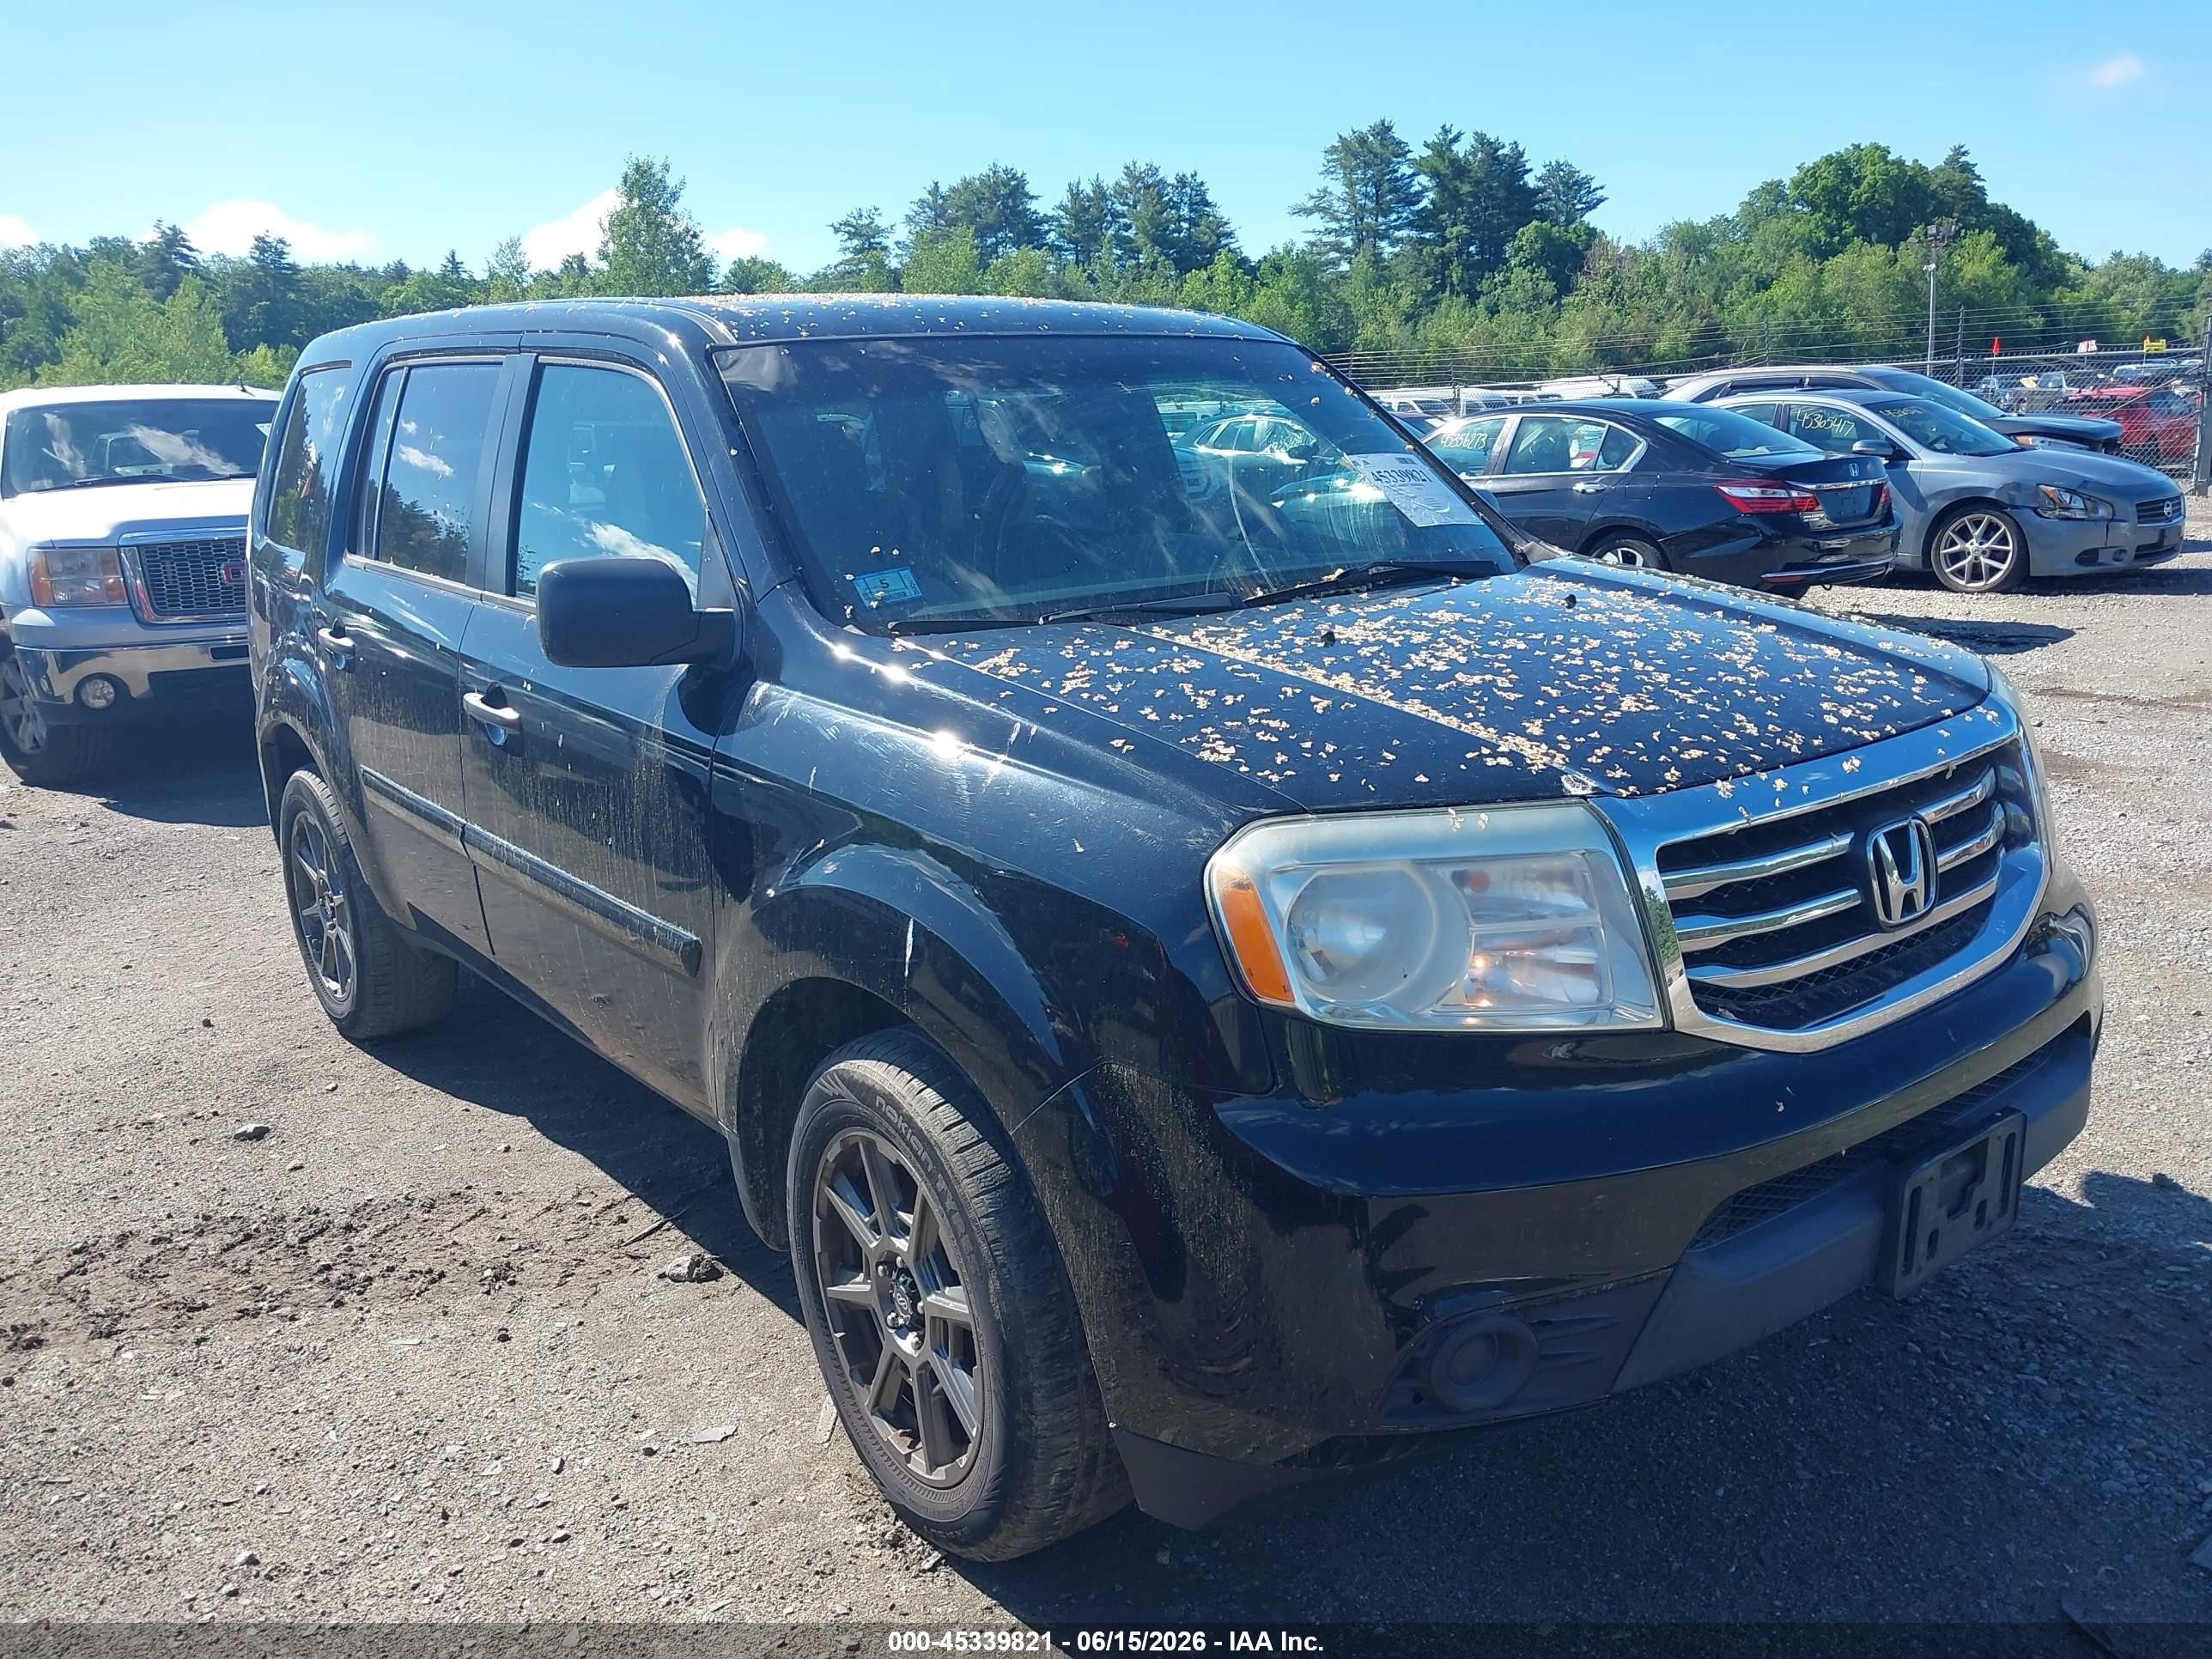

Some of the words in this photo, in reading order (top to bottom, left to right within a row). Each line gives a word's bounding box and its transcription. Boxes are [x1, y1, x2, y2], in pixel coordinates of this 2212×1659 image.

[1796, 409, 1855, 436] 45365417
[1441, 432, 1488, 449] 45356273
[1370, 469, 1433, 483] 45339821
[879, 578, 890, 589] 5
